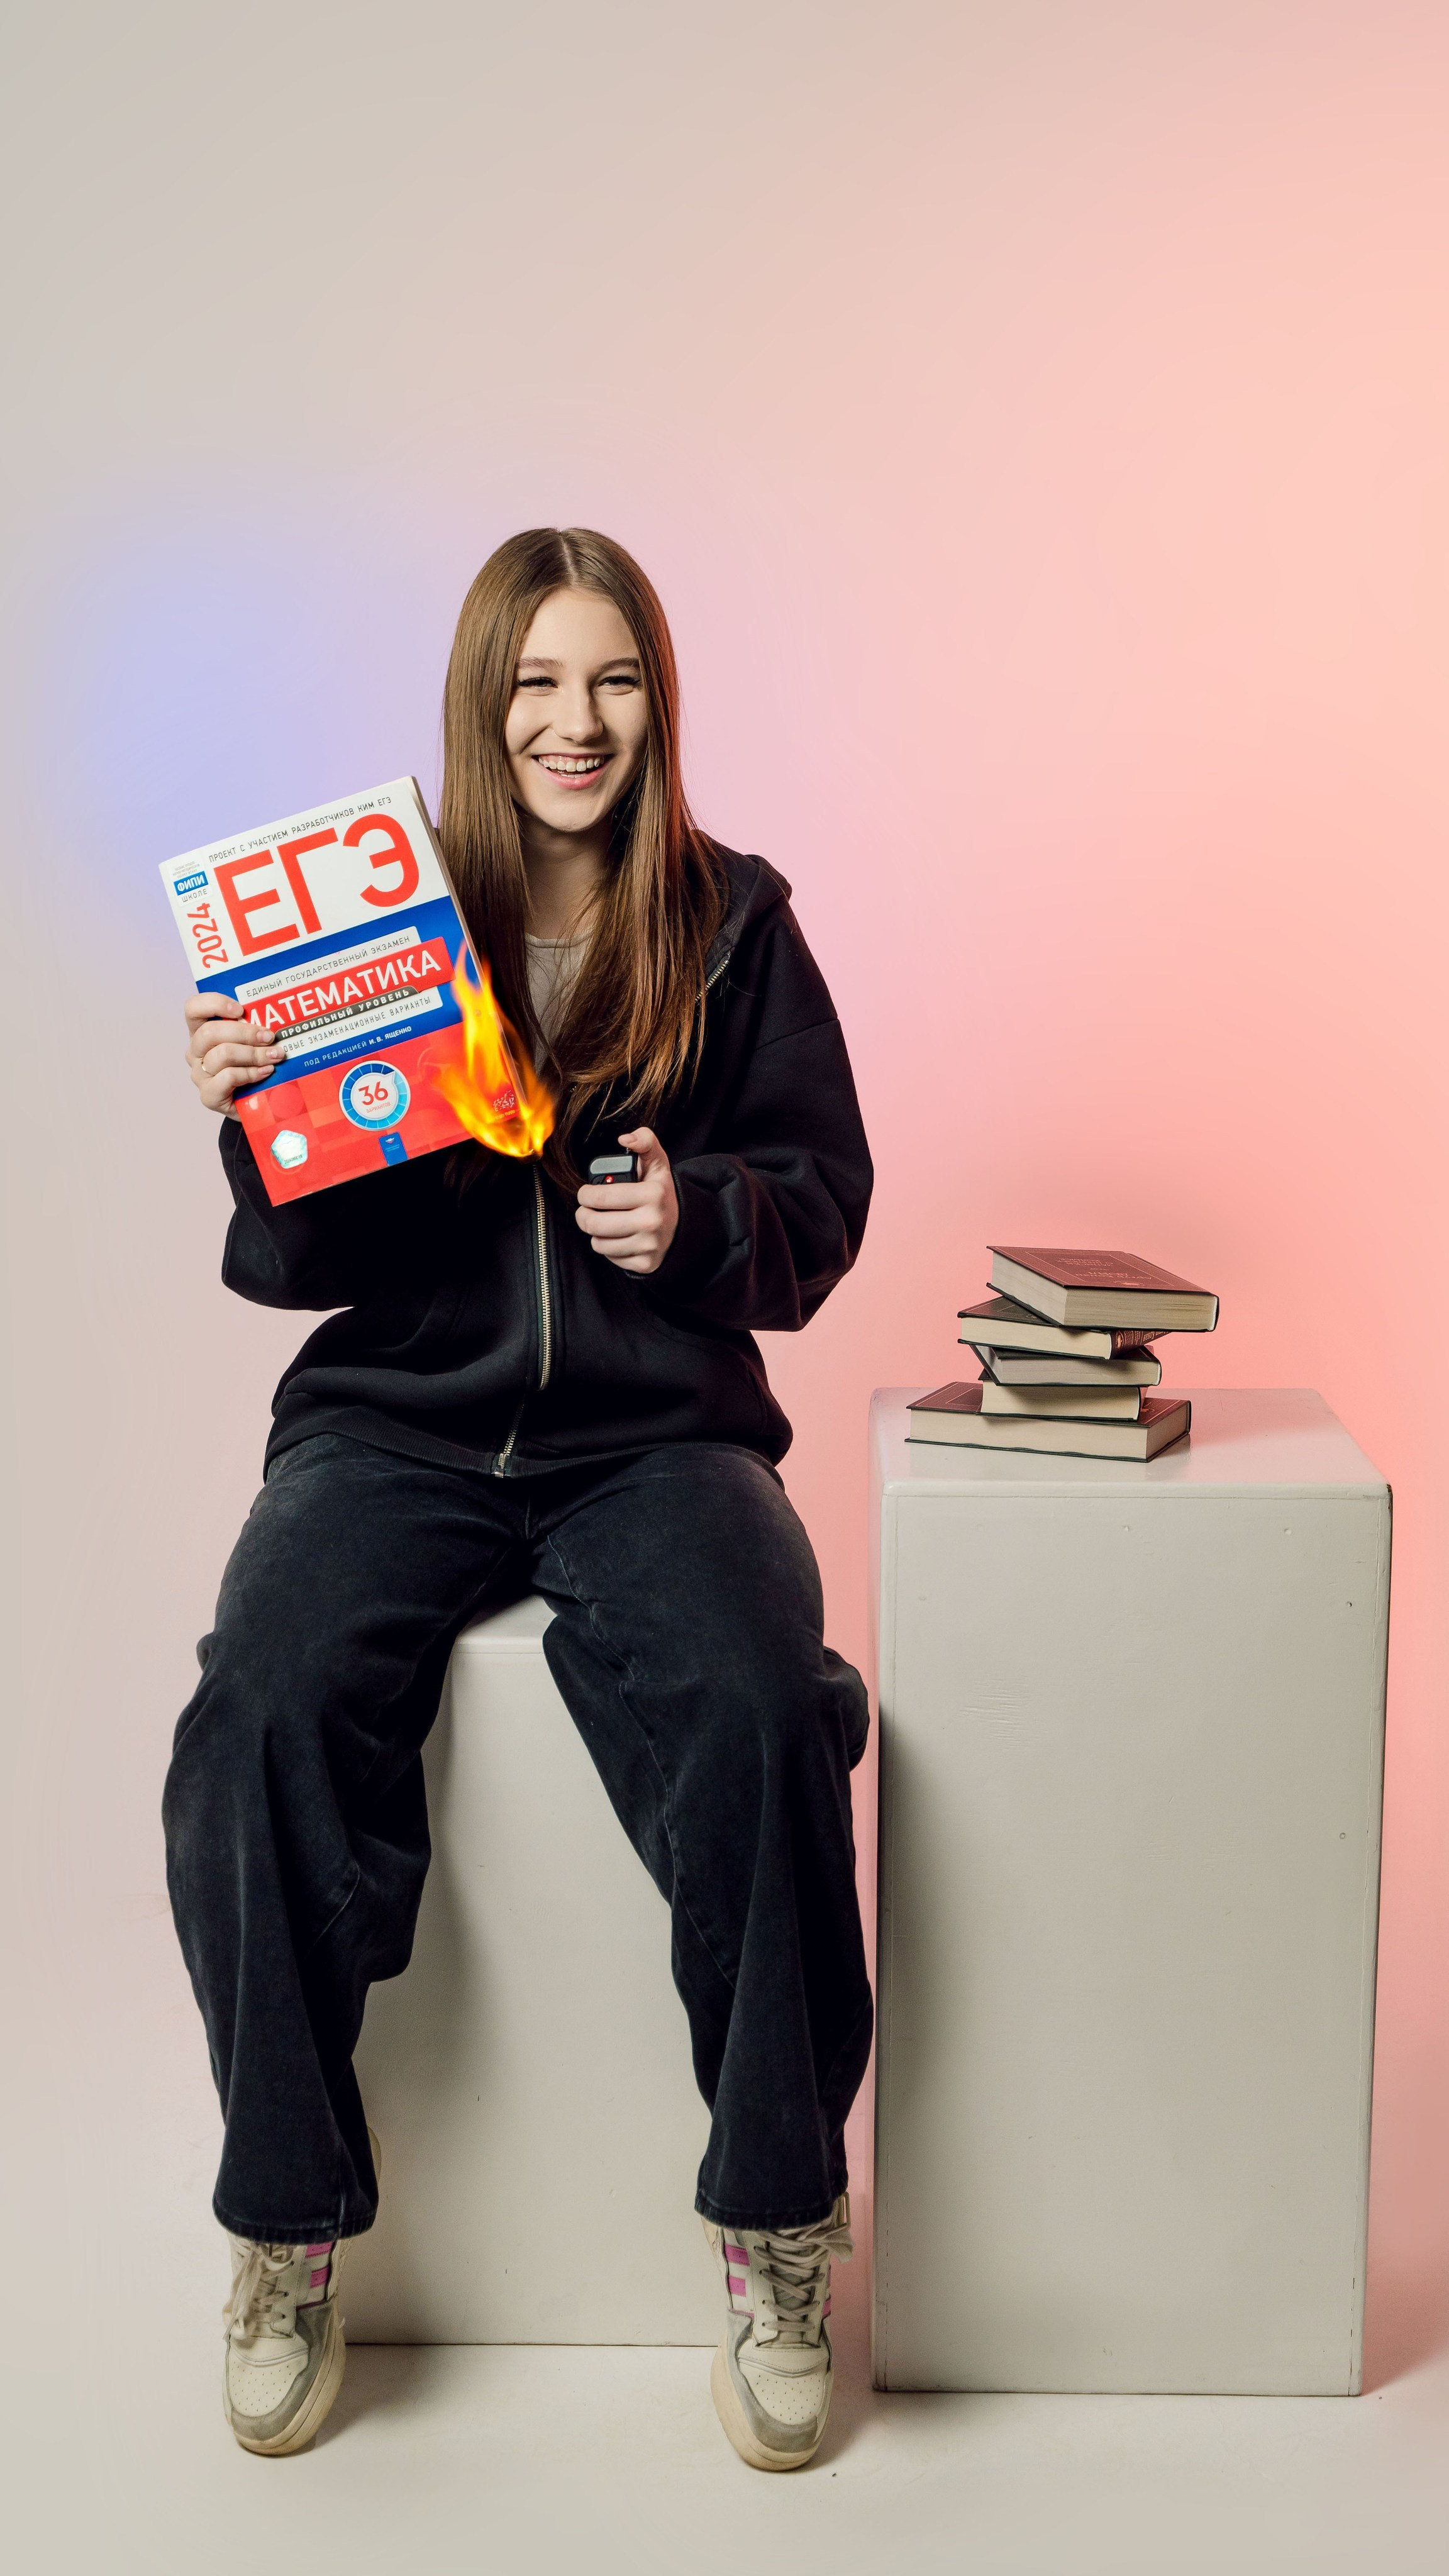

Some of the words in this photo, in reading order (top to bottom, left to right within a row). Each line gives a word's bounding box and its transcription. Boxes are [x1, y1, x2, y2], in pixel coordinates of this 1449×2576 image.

[209, 847, 236, 863] ПРОЕКТ
[248, 830, 289, 849] УЧАСТИЕМ
[291, 808, 354, 835] РАЗРАБОТЧИКОВ
[357, 801, 375, 813] КИМ
[377, 796, 392, 806] ЕГЭ
[177, 874, 205, 892] ФИПИ
[181, 888, 208, 902] ШКОЛЕ
[213, 813, 419, 957] ЕГЭ
[187, 902, 229, 969] 2024
[246, 978, 283, 997] ЕДИНЫЙ
[286, 949, 368, 984] ГОСУДАРСТВЕННЫЙ
[370, 935, 410, 954] ЭКЗАМЕН
[281, 1006, 353, 1038] ПРОФИЛЬНЫЙ
[358, 989, 409, 1011] УРОВЕНЬ
[283, 1040, 304, 1053] ОВЫЕ
[309, 1012, 386, 1044] ЭКЗАМЕНАЦИОННЫЕ
[390, 996, 431, 1016] ВАРИАНТЫ
[304, 1057, 320, 1067] ПОД
[322, 1040, 367, 1061] РЕДАКЦИЕЙ
[384, 1026, 412, 1040] ЯЩЕНКО
[358, 1081, 389, 1106] 36
[366, 1101, 391, 1114] ВАРИАНТОВ
